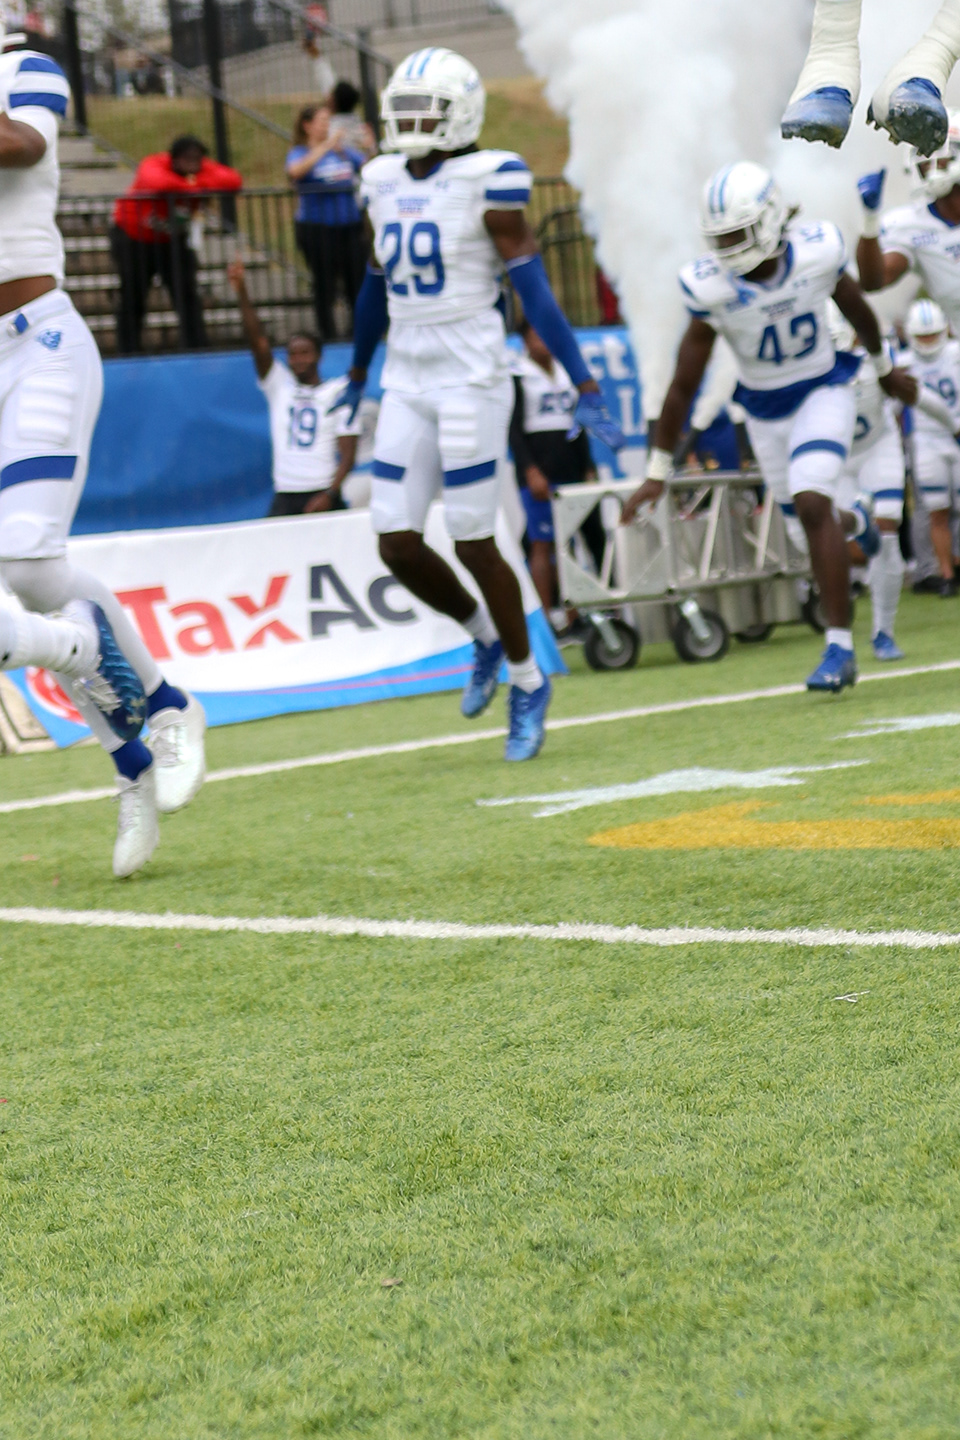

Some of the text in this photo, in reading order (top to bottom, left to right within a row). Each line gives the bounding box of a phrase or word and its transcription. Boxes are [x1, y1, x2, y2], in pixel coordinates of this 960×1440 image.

[381, 221, 446, 296] 29
[287, 406, 318, 449] 19
[115, 562, 417, 661] TaxAc
